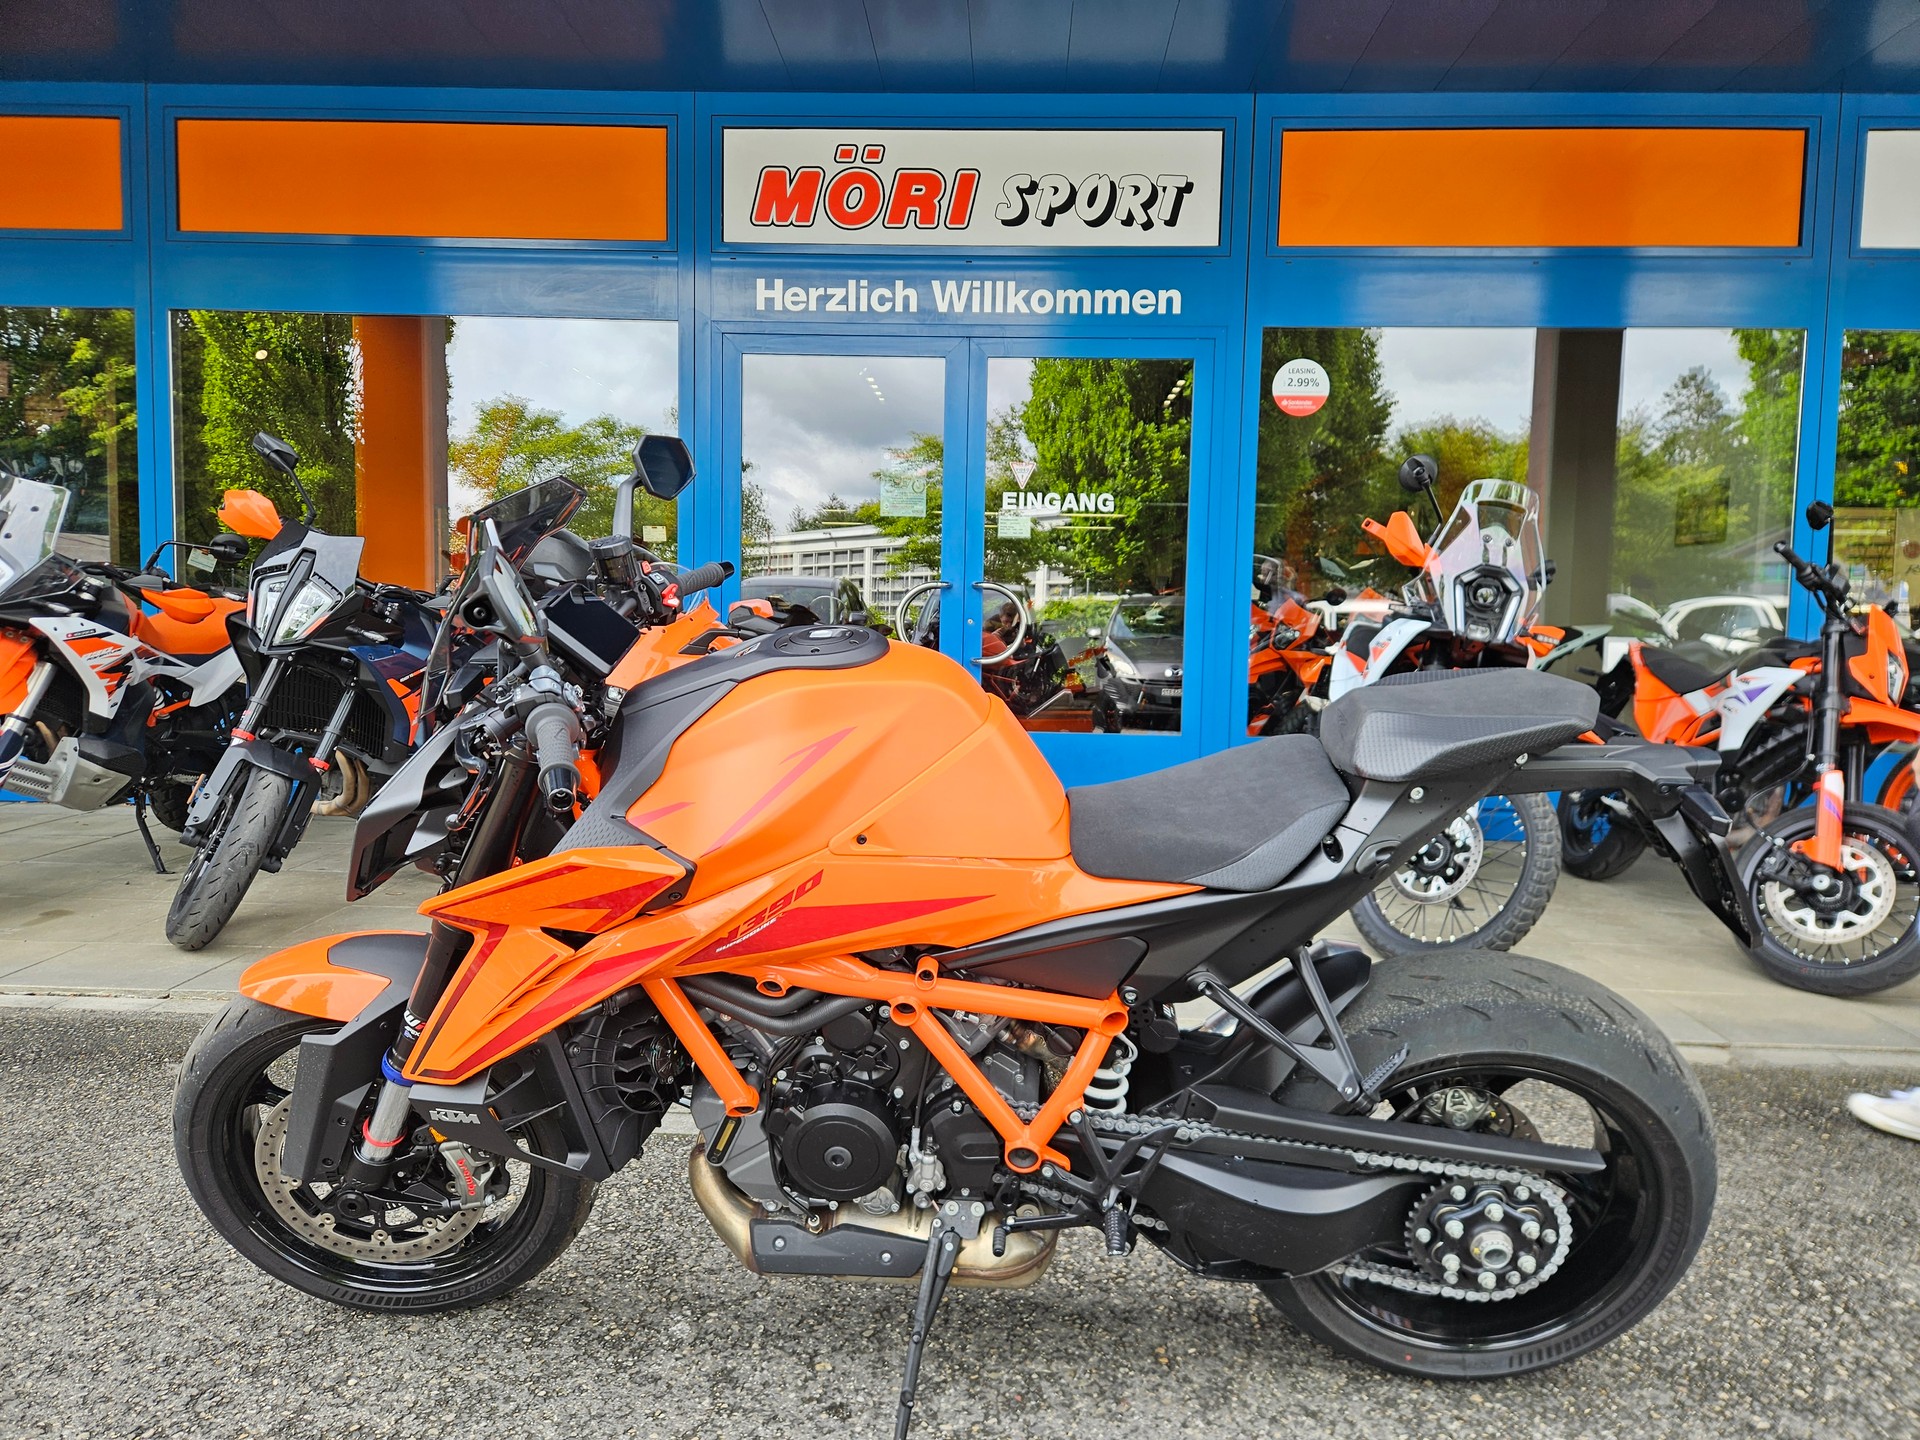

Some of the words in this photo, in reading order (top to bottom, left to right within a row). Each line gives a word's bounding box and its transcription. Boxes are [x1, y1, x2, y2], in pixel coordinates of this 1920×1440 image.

[750, 144, 981, 230] MÖRI
[995, 173, 1194, 231] SPORT
[756, 278, 918, 313] Herzlich
[932, 280, 1182, 315] Willkommen
[1287, 377, 1320, 387] 2.99%
[1002, 491, 1115, 513] EINGANG
[428, 1108, 481, 1125] KTM
[457, 1158, 477, 1196] brembo
